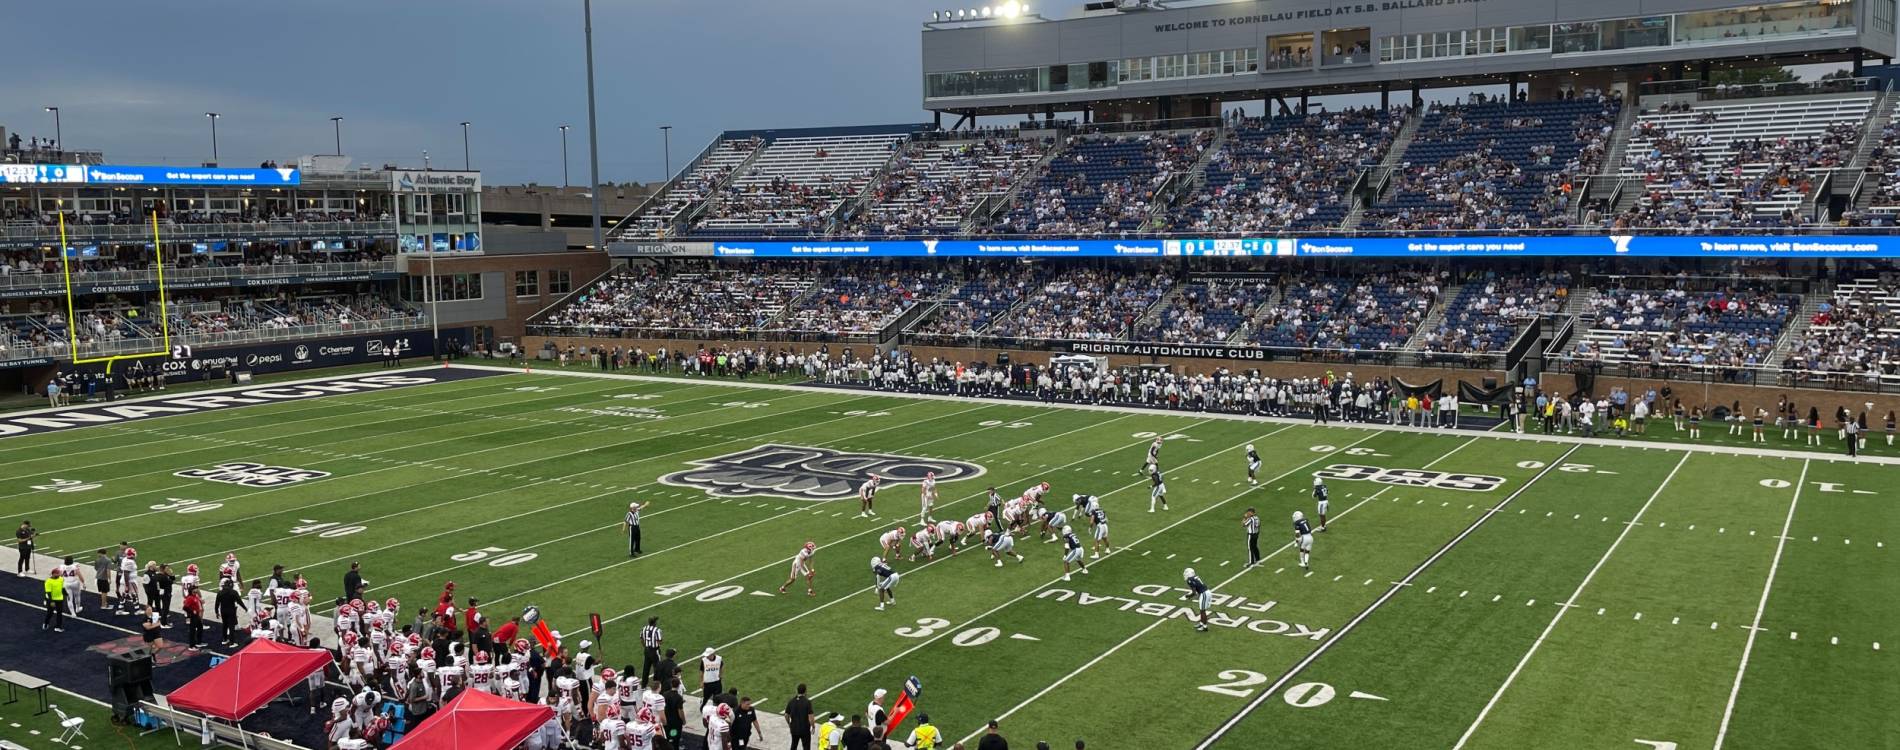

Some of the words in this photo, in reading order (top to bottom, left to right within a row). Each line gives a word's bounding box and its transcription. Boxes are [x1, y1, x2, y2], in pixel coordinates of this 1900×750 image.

[1155, 21, 1208, 32] WELCOME
[1212, 18, 1225, 27] TO
[1229, 12, 1293, 25] KORNBLAU
[1297, 8, 1332, 19] FIELD
[1336, 6, 1351, 15] AT
[1354, 4, 1378, 13] S.B.
[1382, 0, 1443, 11] BALLARD
[416, 174, 455, 184] Atlantic
[457, 175, 476, 186] Bay
[637, 245, 668, 254] REIGN
[670, 245, 686, 254] ON
[1408, 243, 1423, 251] Get
[1424, 243, 1438, 251] the
[1439, 244, 1465, 252] expert
[1486, 244, 1501, 252] you
[1503, 243, 1524, 251] need
[1700, 242, 1712, 251] To
[1714, 242, 1739, 251] learn
[1740, 243, 1767, 252] more,
[1770, 242, 1791, 251] visit
[1793, 242, 1878, 251] BonSecours.com
[174, 345, 191, 359] 27
[1073, 343, 1128, 354] PRIORITY
[1133, 345, 1223, 358] AUTOMOTIVE
[1228, 348, 1264, 359] CLUB
[258, 353, 282, 365] pepsi
[162, 361, 186, 371] COX
[1310, 445, 1376, 456] 30
[1517, 461, 1595, 472] 20
[1760, 479, 1845, 492] 10
[289, 521, 367, 538] 40
[451, 547, 538, 567] 50
[653, 579, 744, 602] 40
[1132, 584, 1278, 613] FIELD
[1036, 588, 1330, 641] KORNBLAU
[894, 616, 1000, 647] 30
[474, 673, 489, 684] 28
[1198, 669, 1336, 707] 20
